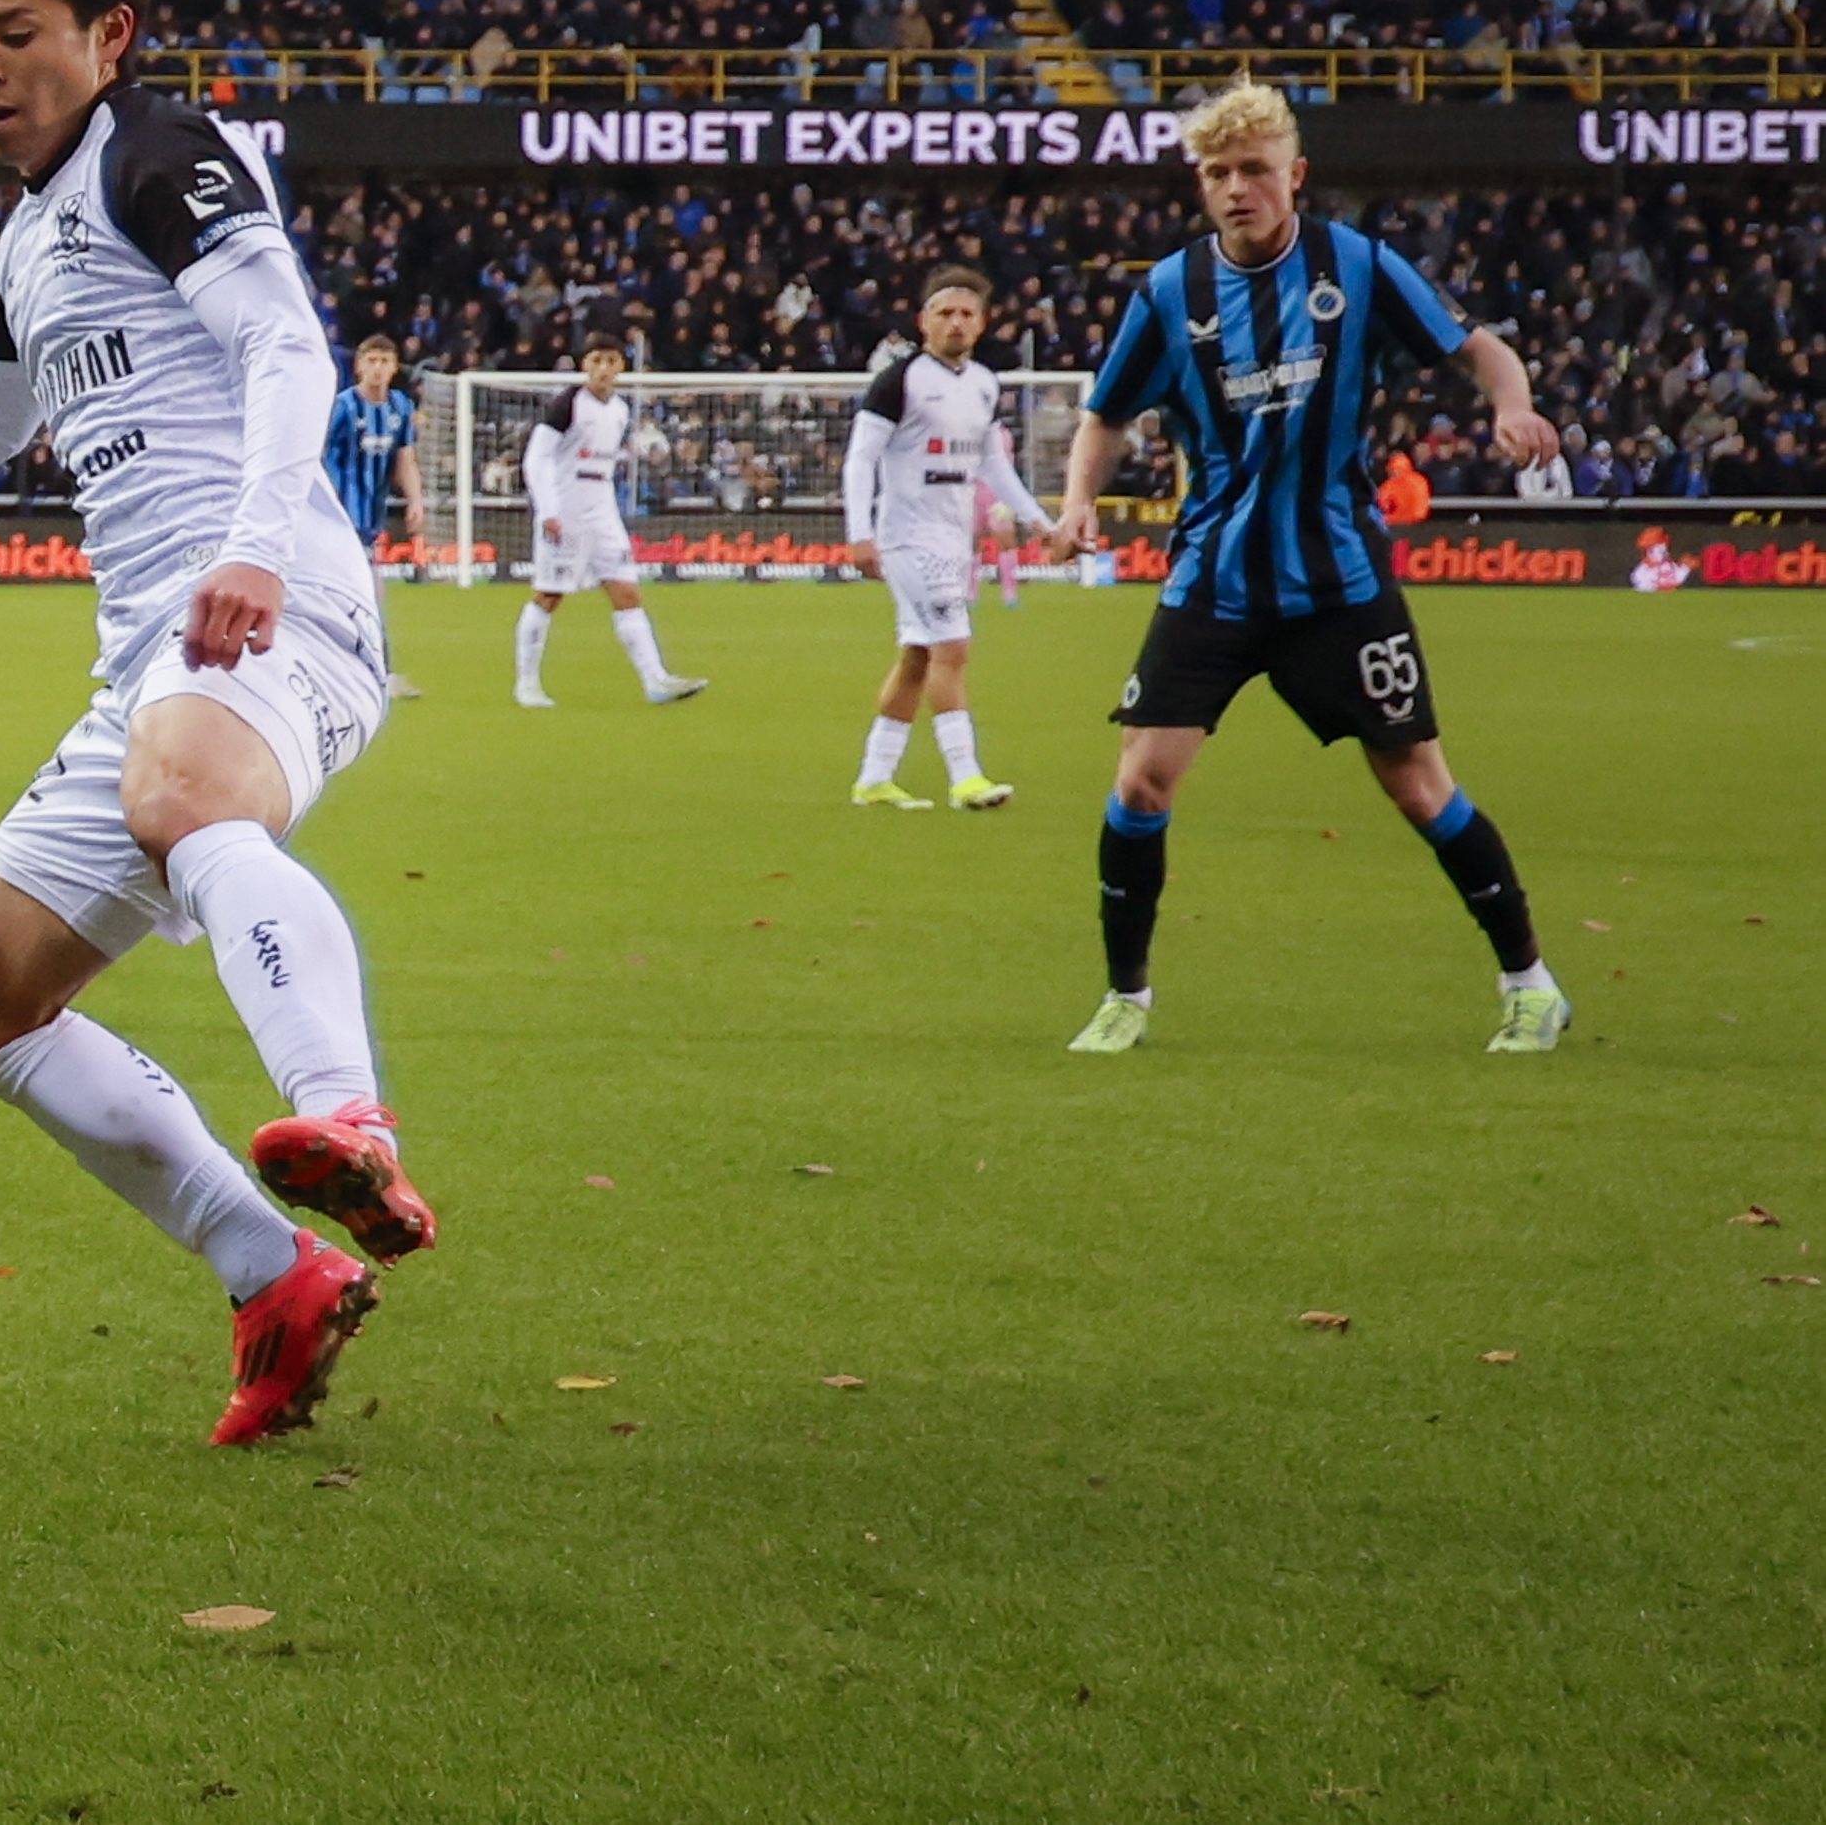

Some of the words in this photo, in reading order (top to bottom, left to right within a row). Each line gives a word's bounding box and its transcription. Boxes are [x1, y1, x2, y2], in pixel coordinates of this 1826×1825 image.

[520, 110, 772, 164] UNIBET
[785, 110, 1080, 164] EXPERTS
[1094, 110, 1200, 164] AP
[1578, 109, 1826, 164] UNIBET
[1357, 632, 1420, 699] 65
